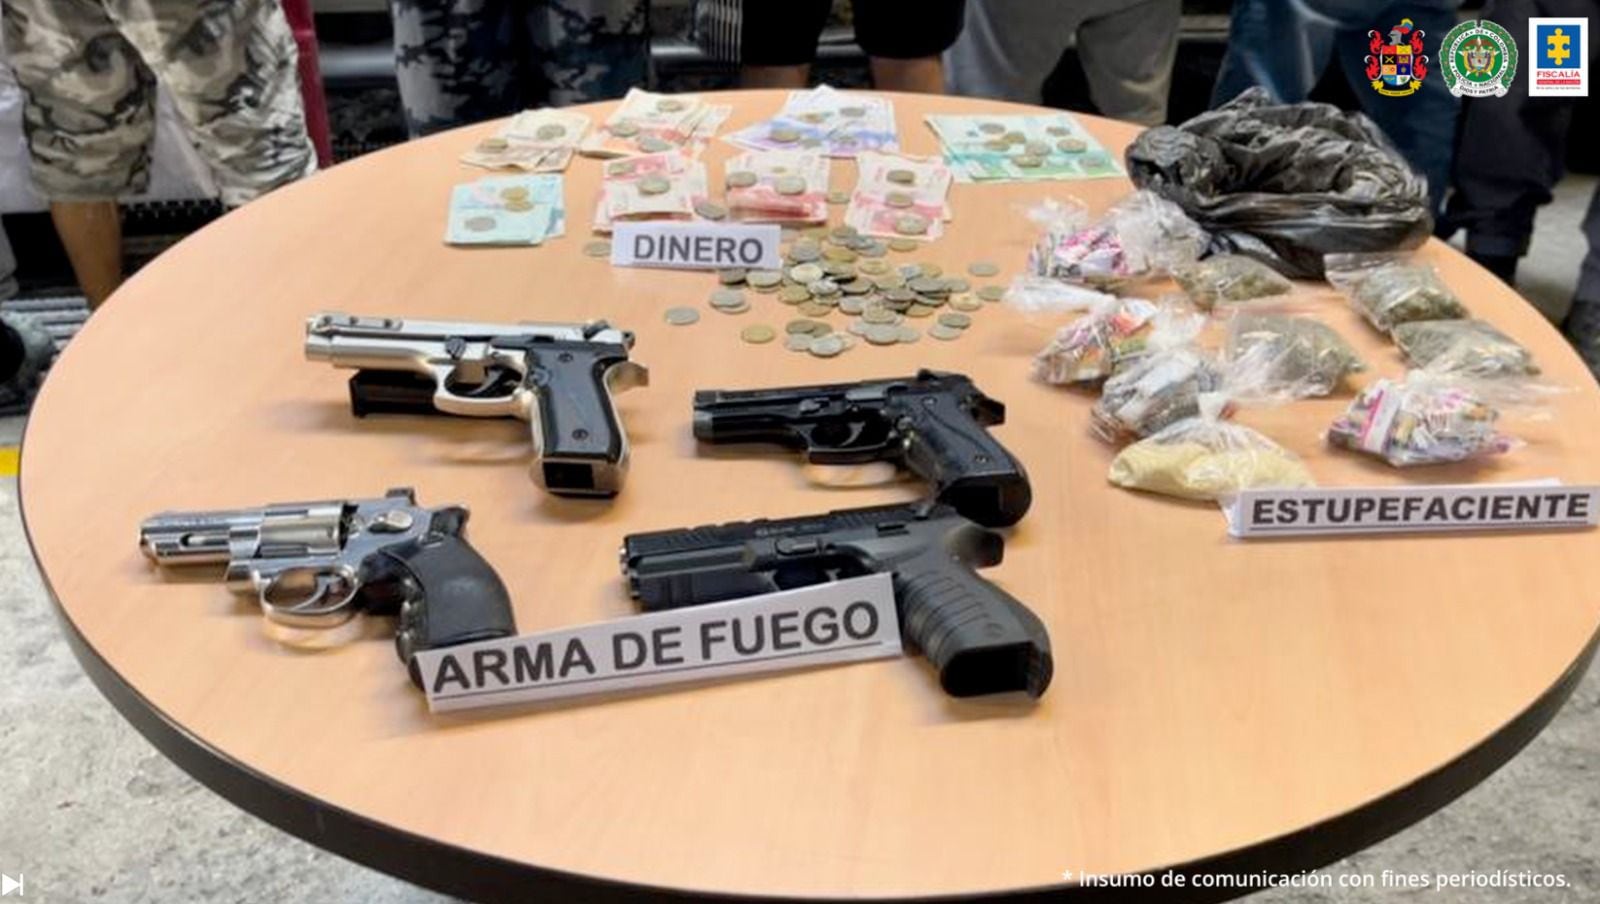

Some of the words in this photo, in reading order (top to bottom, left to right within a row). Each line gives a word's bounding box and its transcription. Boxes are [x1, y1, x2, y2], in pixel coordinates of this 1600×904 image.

[633, 234, 764, 264] DINERO
[1252, 493, 1590, 525] ESTUPEFACIENTE
[432, 637, 597, 693] ARMA
[612, 626, 684, 671] DE
[700, 600, 881, 660] FUEGO
